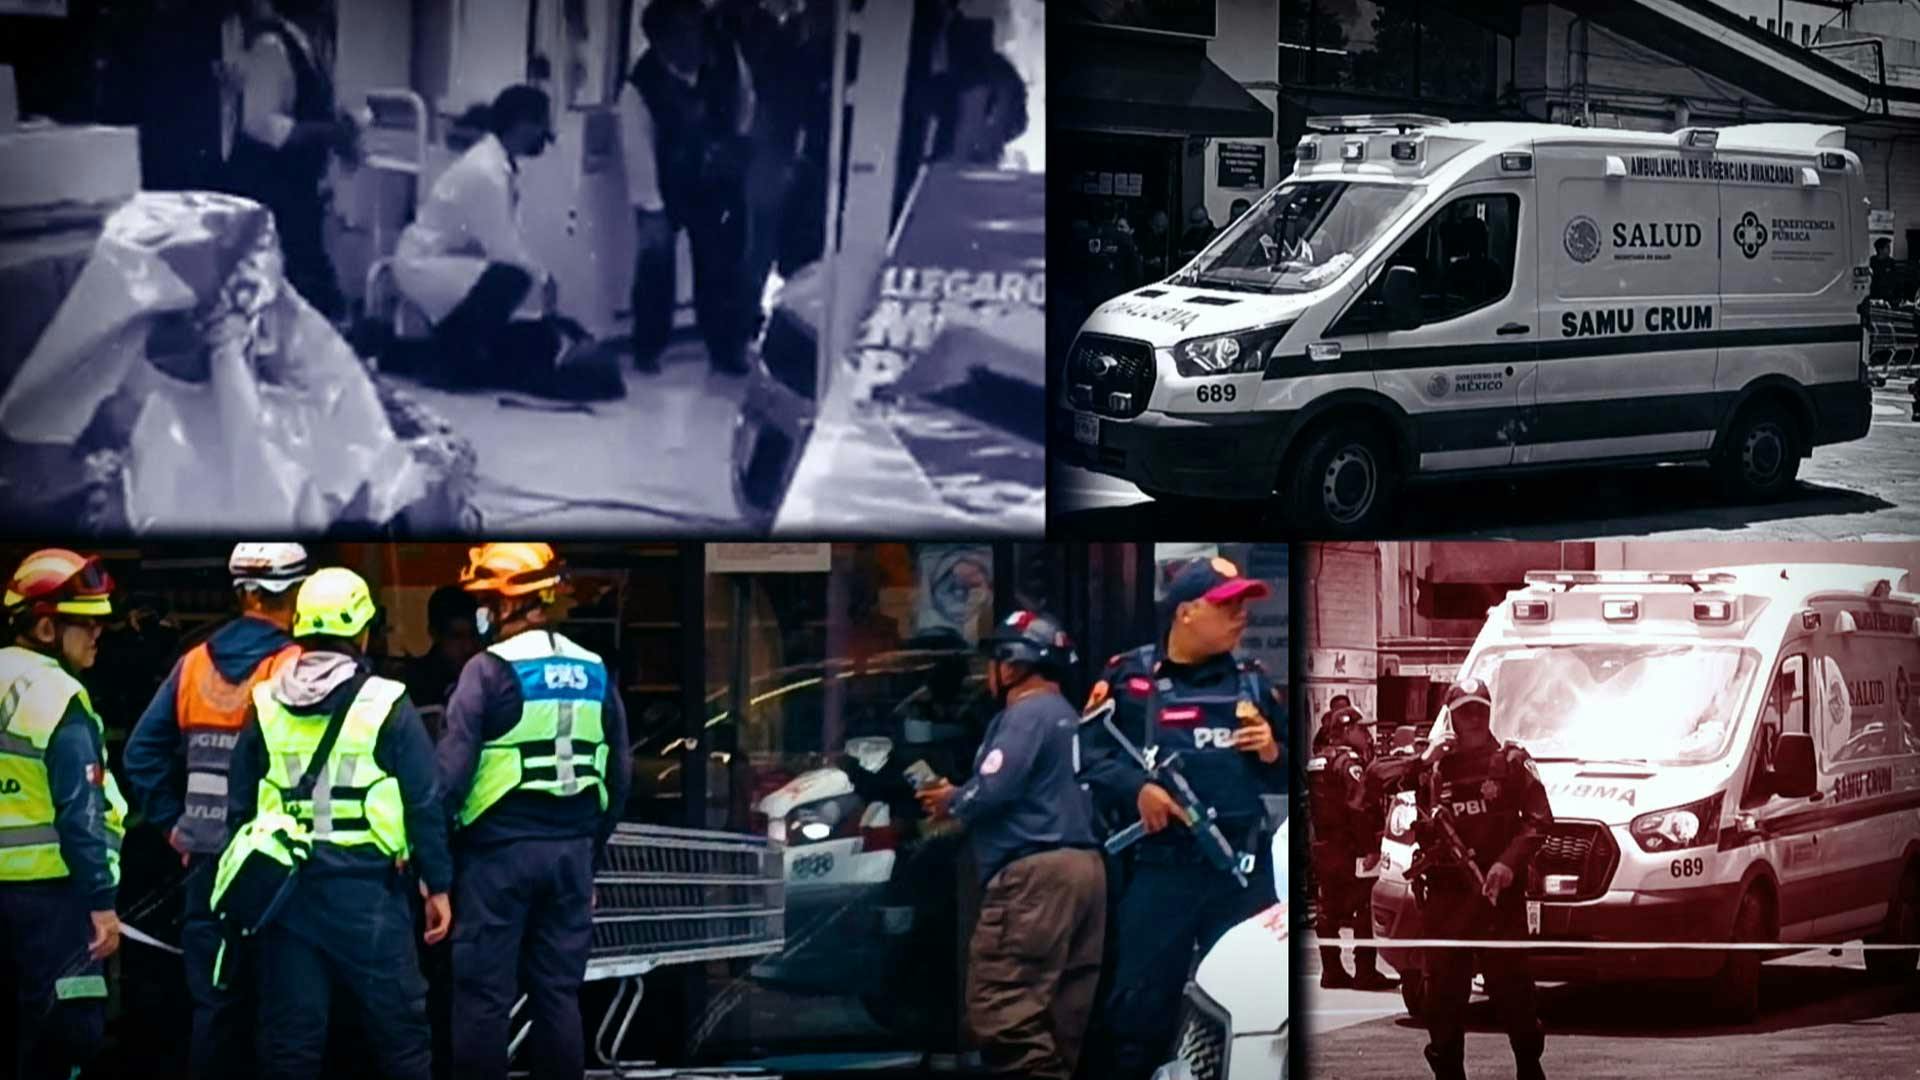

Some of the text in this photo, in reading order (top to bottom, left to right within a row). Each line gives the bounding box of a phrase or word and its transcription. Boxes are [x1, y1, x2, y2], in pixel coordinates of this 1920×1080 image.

[1631, 157, 1794, 184] AMBULANCIA DE URGENCIAS AVANZADAS
[1613, 222, 1701, 247] SALUD
[1561, 306, 1712, 337] SAMU CRUM
[1196, 383, 1237, 402] 689
[1847, 680, 1885, 706] SALUD
[1193, 727, 1237, 749] PB
[1452, 798, 1487, 817] PBI
[1671, 857, 1704, 878] 689
